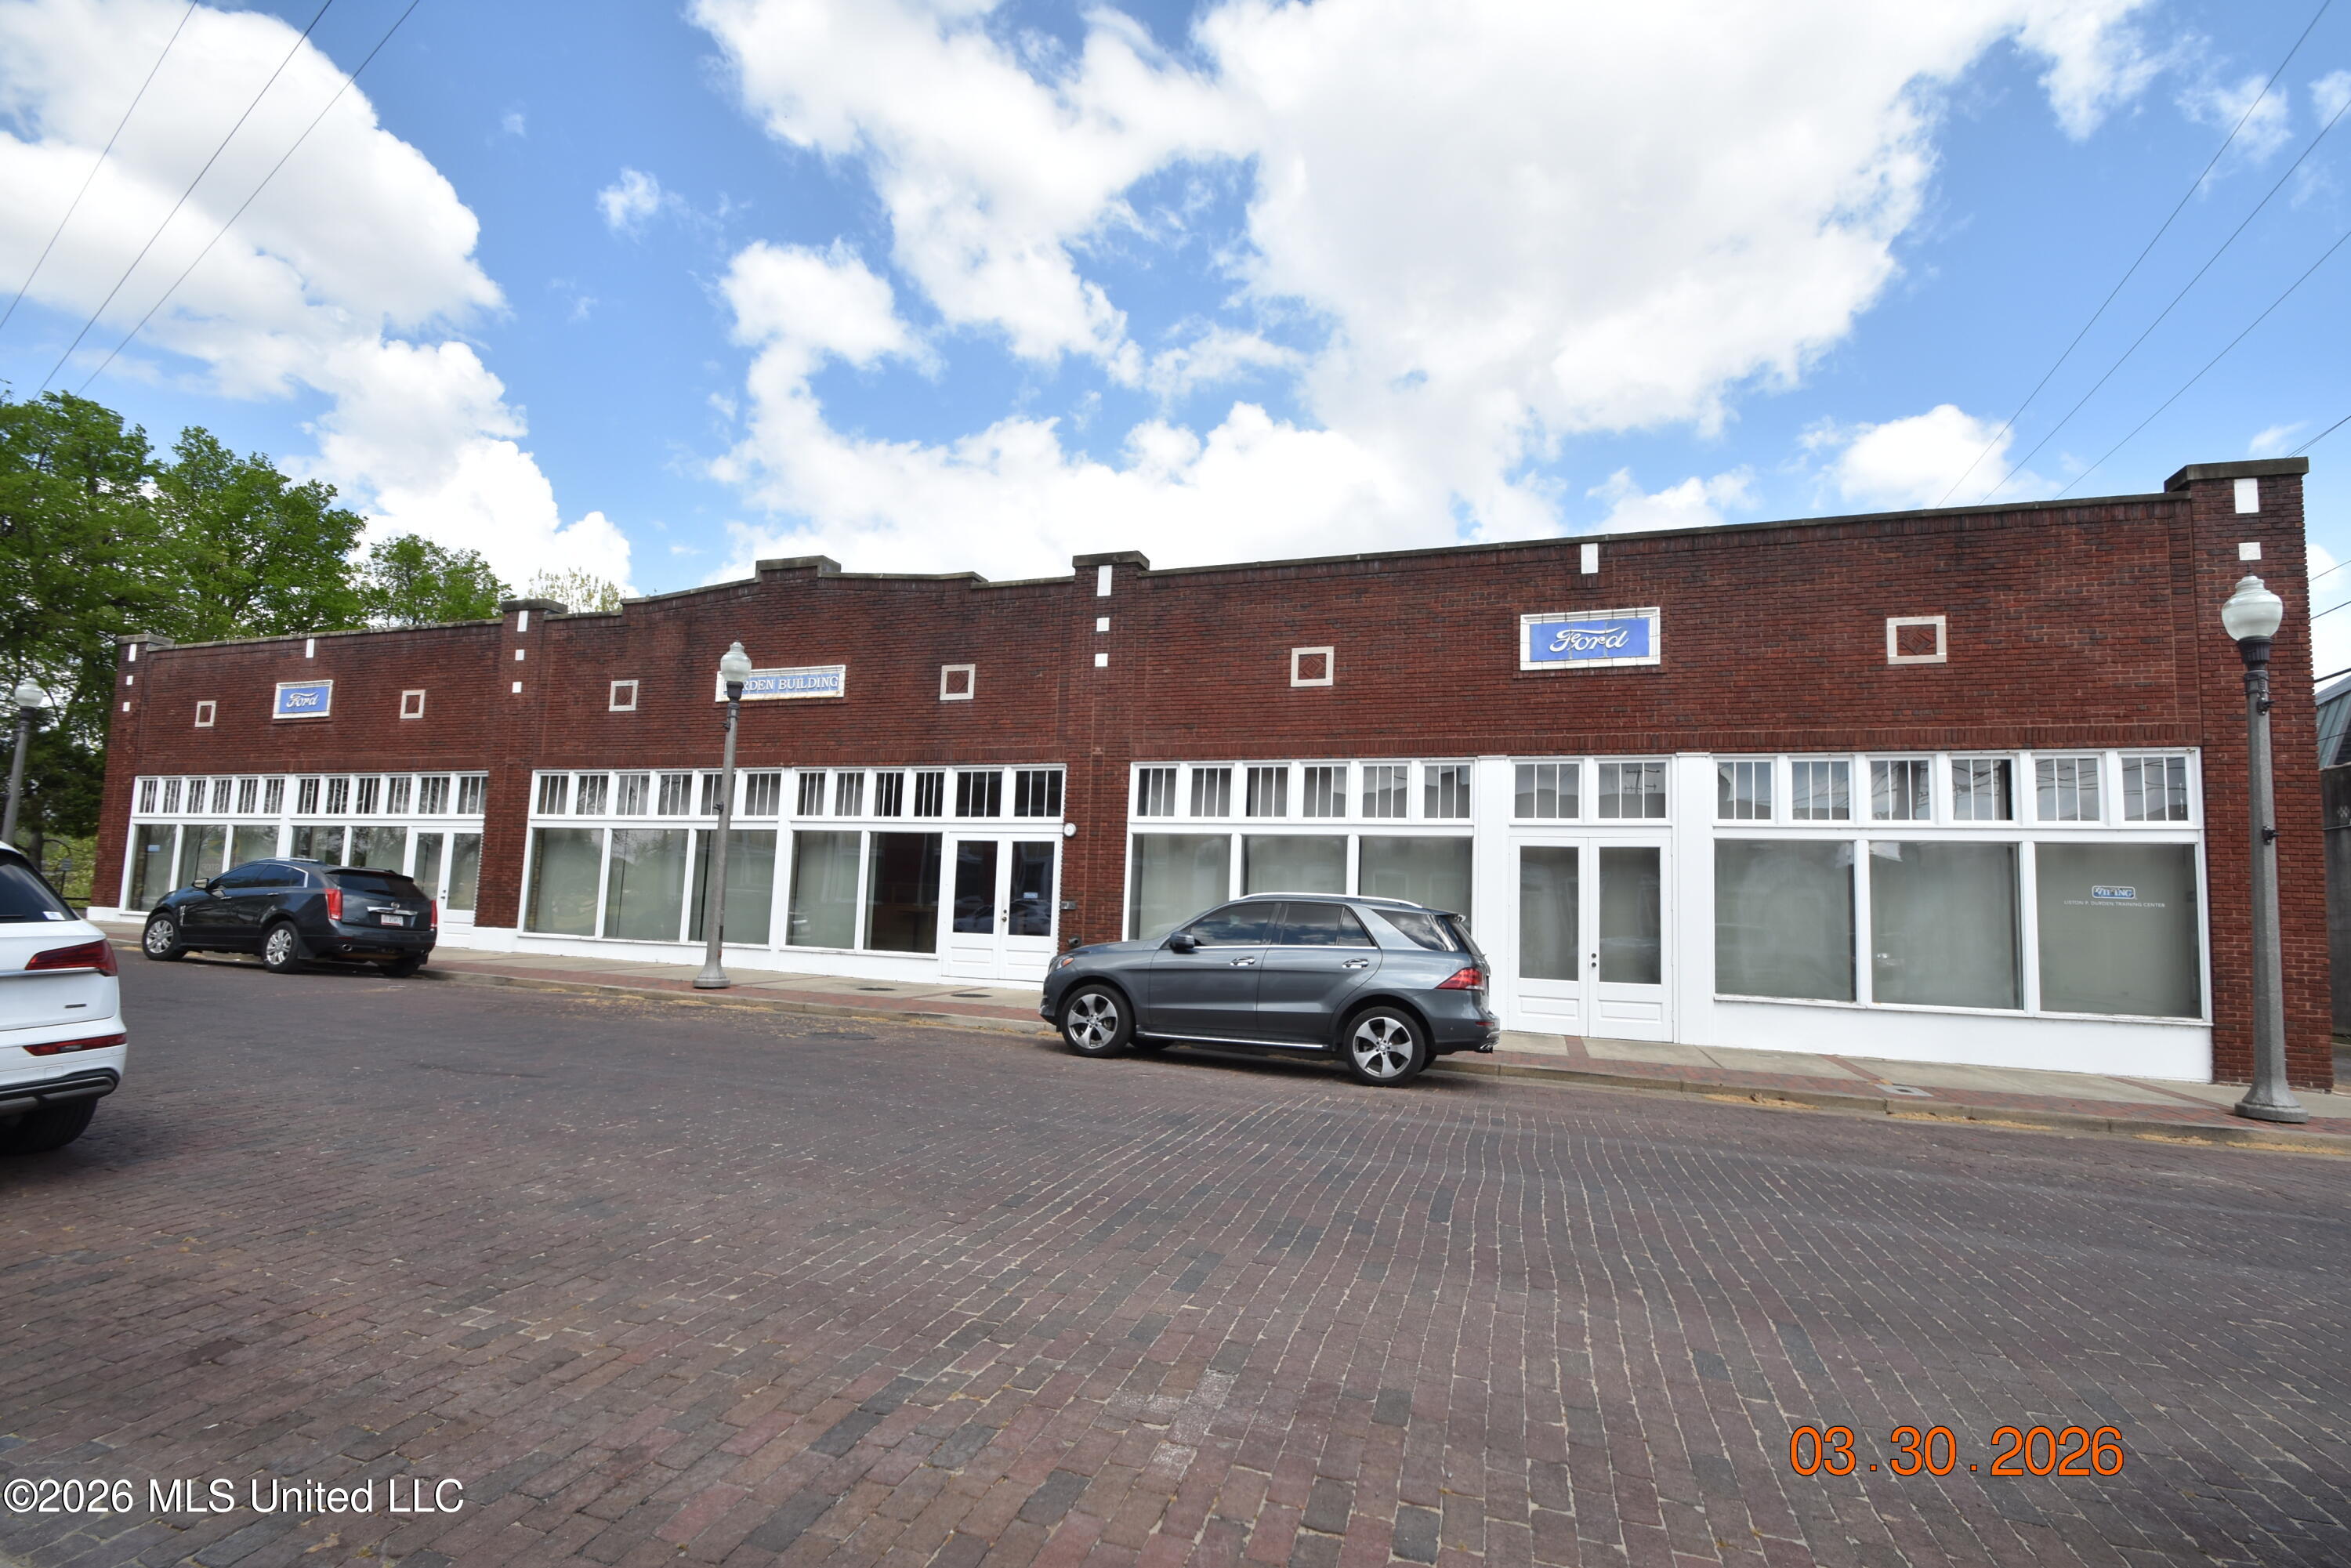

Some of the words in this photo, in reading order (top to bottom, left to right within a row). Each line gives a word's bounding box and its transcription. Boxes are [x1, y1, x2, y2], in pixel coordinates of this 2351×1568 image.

[1549, 626, 1630, 653] Ford
[724, 679, 773, 691] RDEN
[778, 675, 839, 690] BUILDING
[286, 691, 319, 707] Ford
